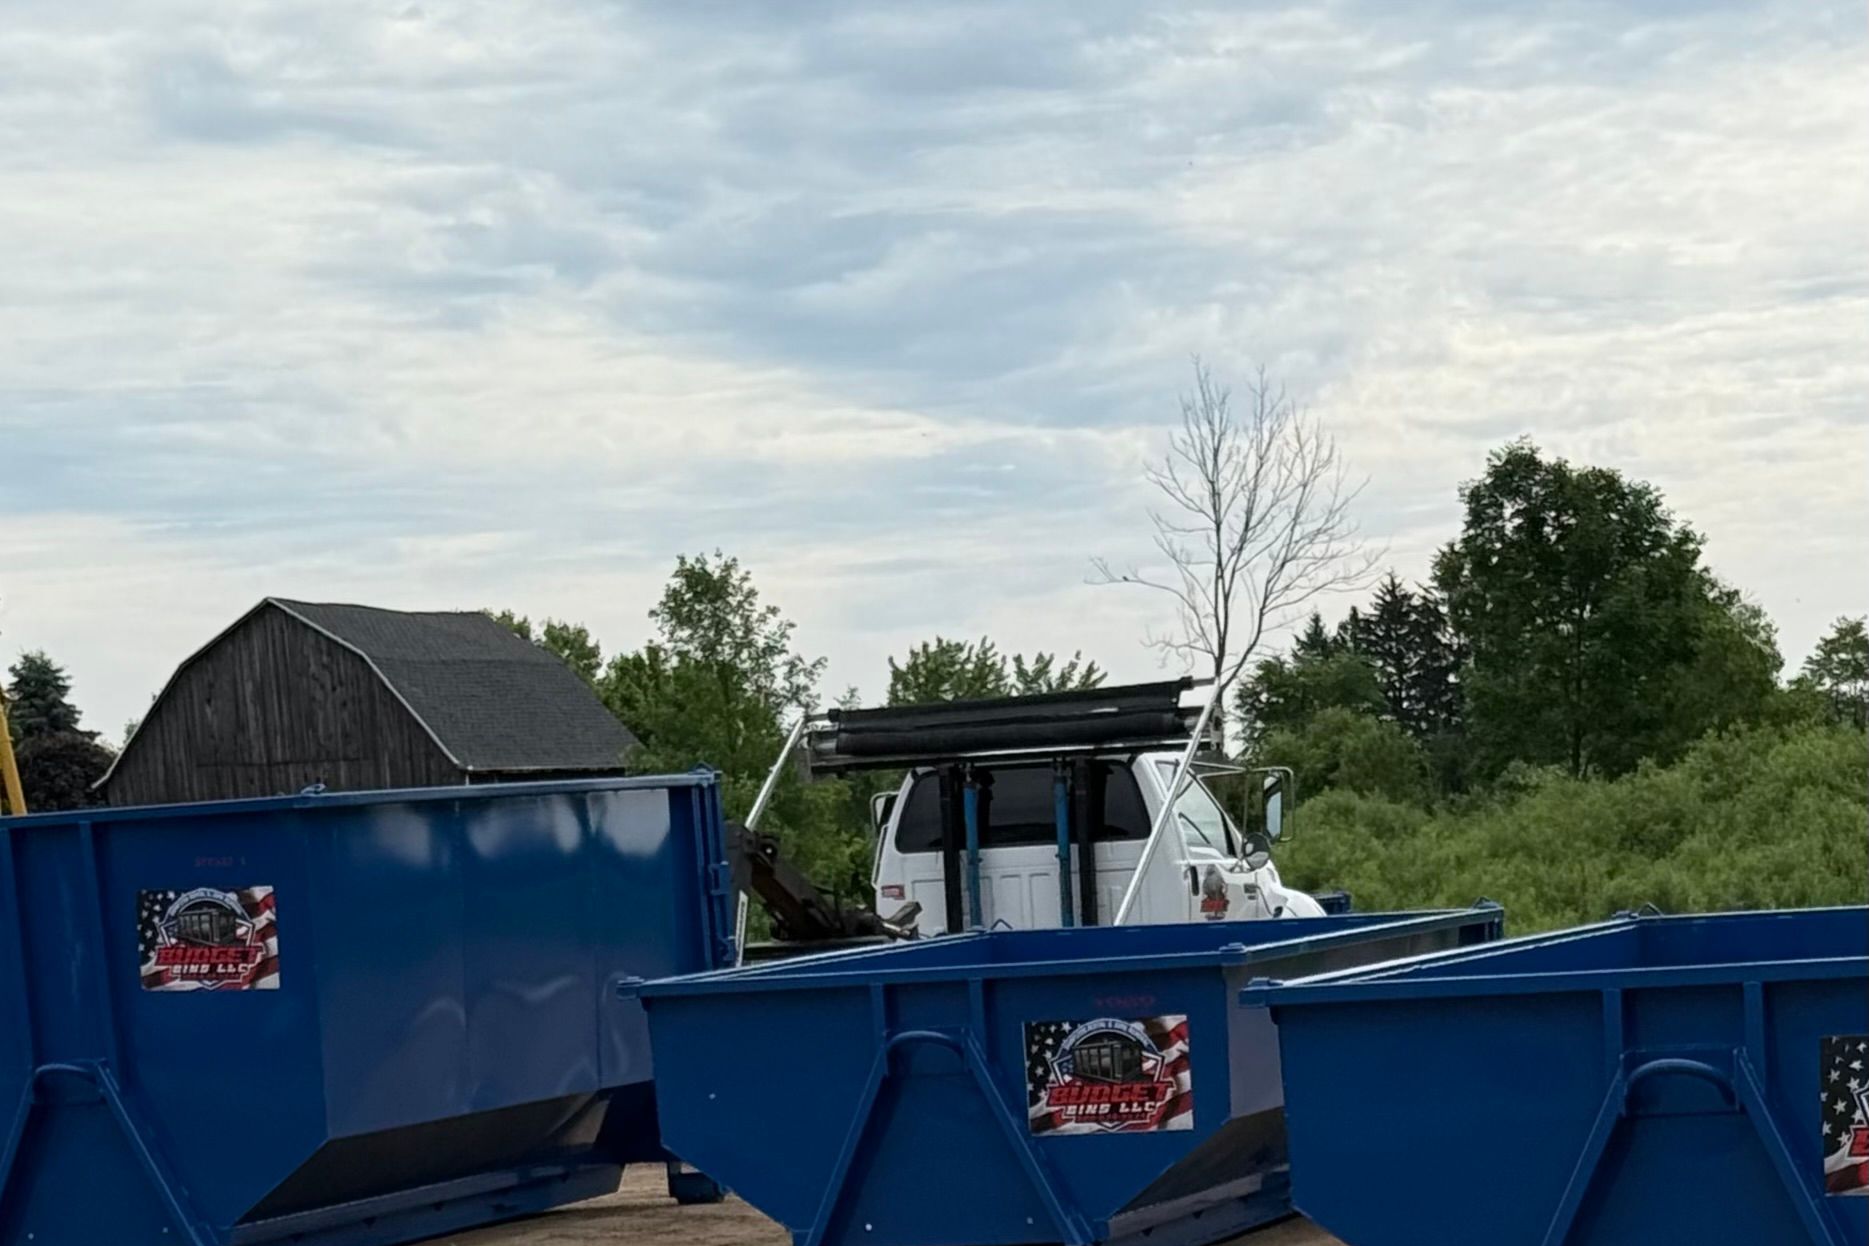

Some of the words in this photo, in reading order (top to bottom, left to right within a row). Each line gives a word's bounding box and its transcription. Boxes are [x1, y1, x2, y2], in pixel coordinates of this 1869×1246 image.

[158, 947, 260, 963] BUDGET
[172, 963, 210, 973] BINS
[216, 963, 248, 973] LLC
[1049, 1083, 1170, 1104] BUDGET
[1066, 1103, 1111, 1115] BINS
[1119, 1101, 1156, 1113] LLC
